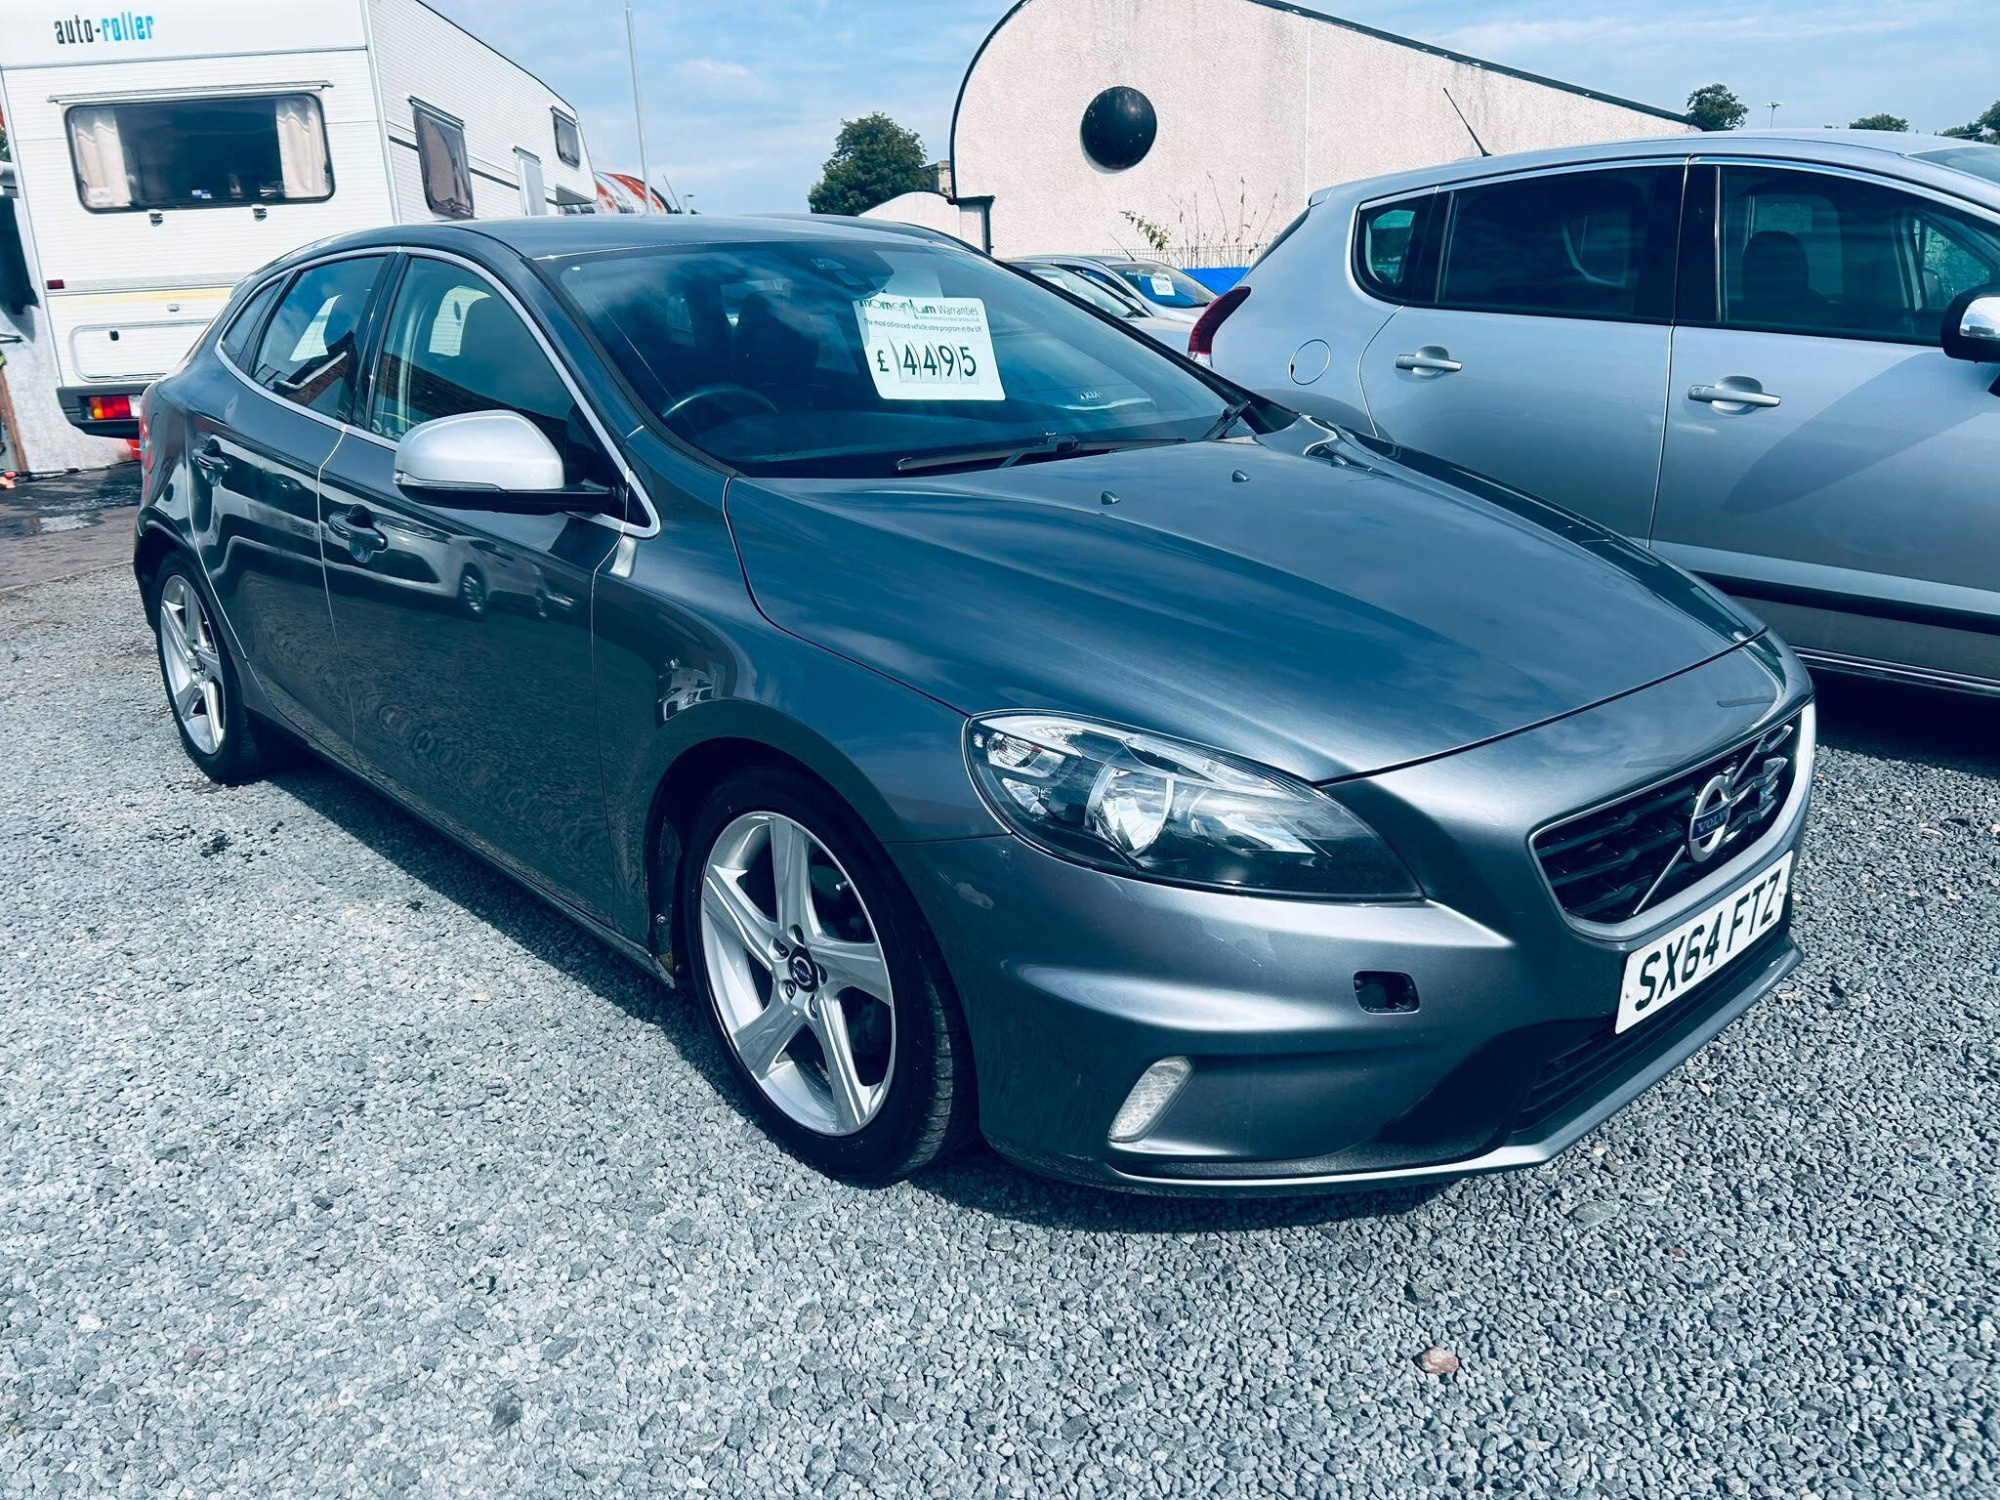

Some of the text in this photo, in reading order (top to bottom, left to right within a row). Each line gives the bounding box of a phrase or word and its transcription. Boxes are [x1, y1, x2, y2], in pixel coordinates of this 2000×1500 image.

[54, 12, 154, 44] auto-roller
[864, 317, 873, 326] The
[874, 320, 886, 328] most
[887, 321, 910, 329] advanced
[911, 322, 927, 331] vehicle
[937, 305, 979, 316] Warranties
[903, 344, 976, 377] 4495
[1635, 869, 1782, 1011] SX64 FTZ
